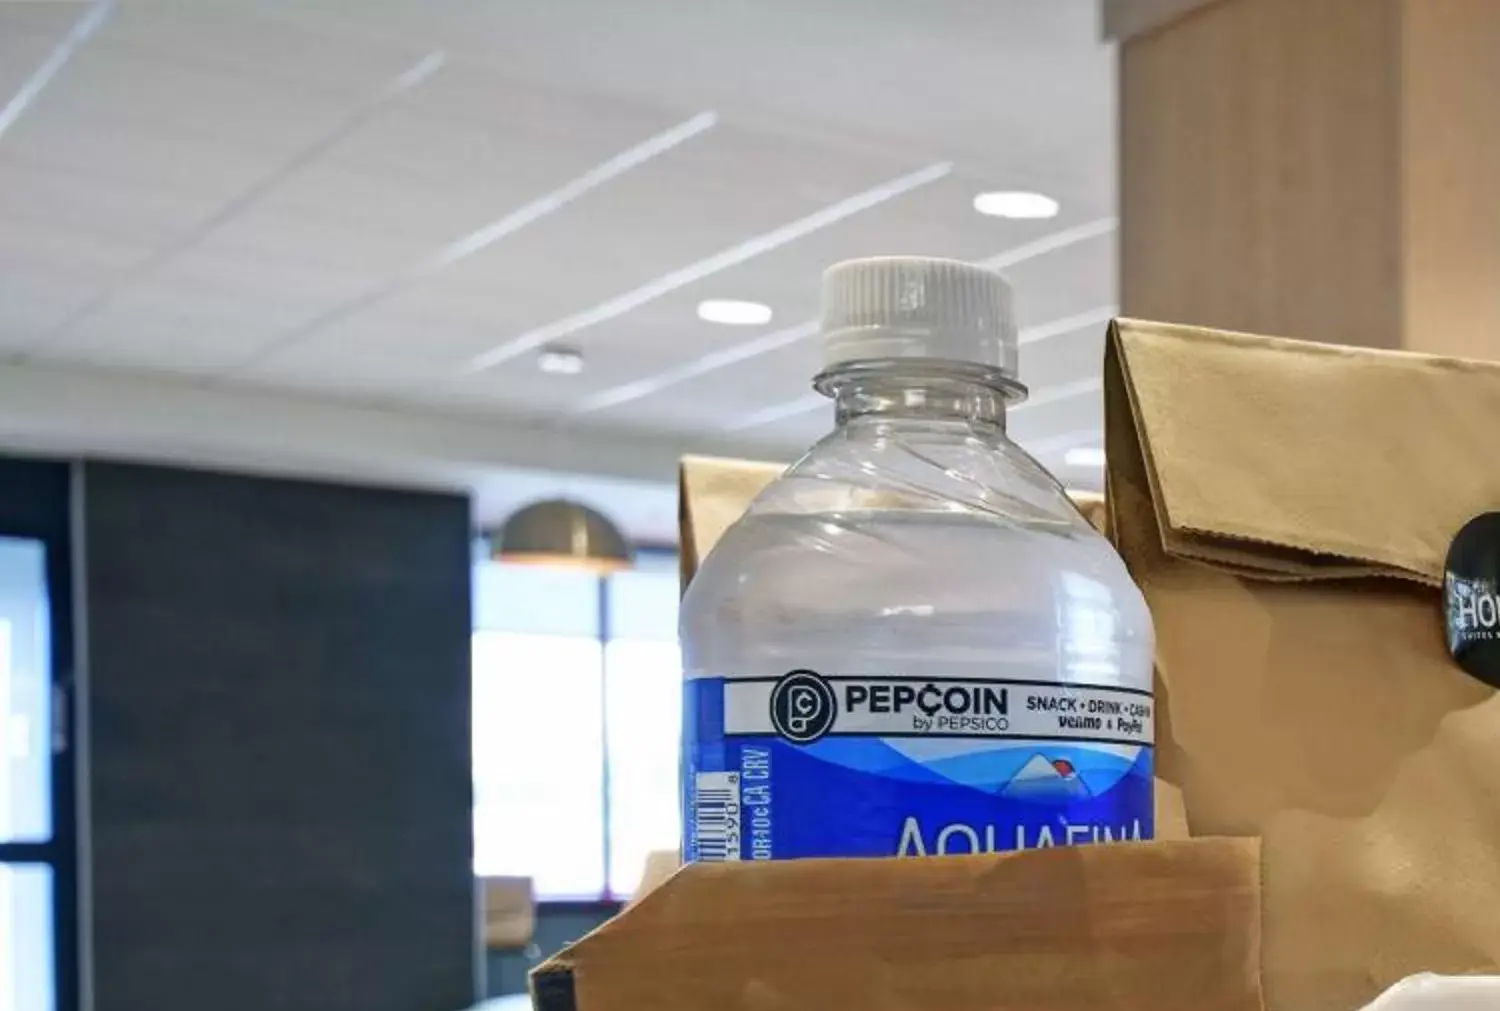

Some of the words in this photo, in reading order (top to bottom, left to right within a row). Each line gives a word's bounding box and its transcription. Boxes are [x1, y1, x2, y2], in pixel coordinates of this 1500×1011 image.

[1026, 695, 1077, 713] SNACK
[912, 714, 933, 732] by
[937, 715, 1009, 731] PEPSICO
